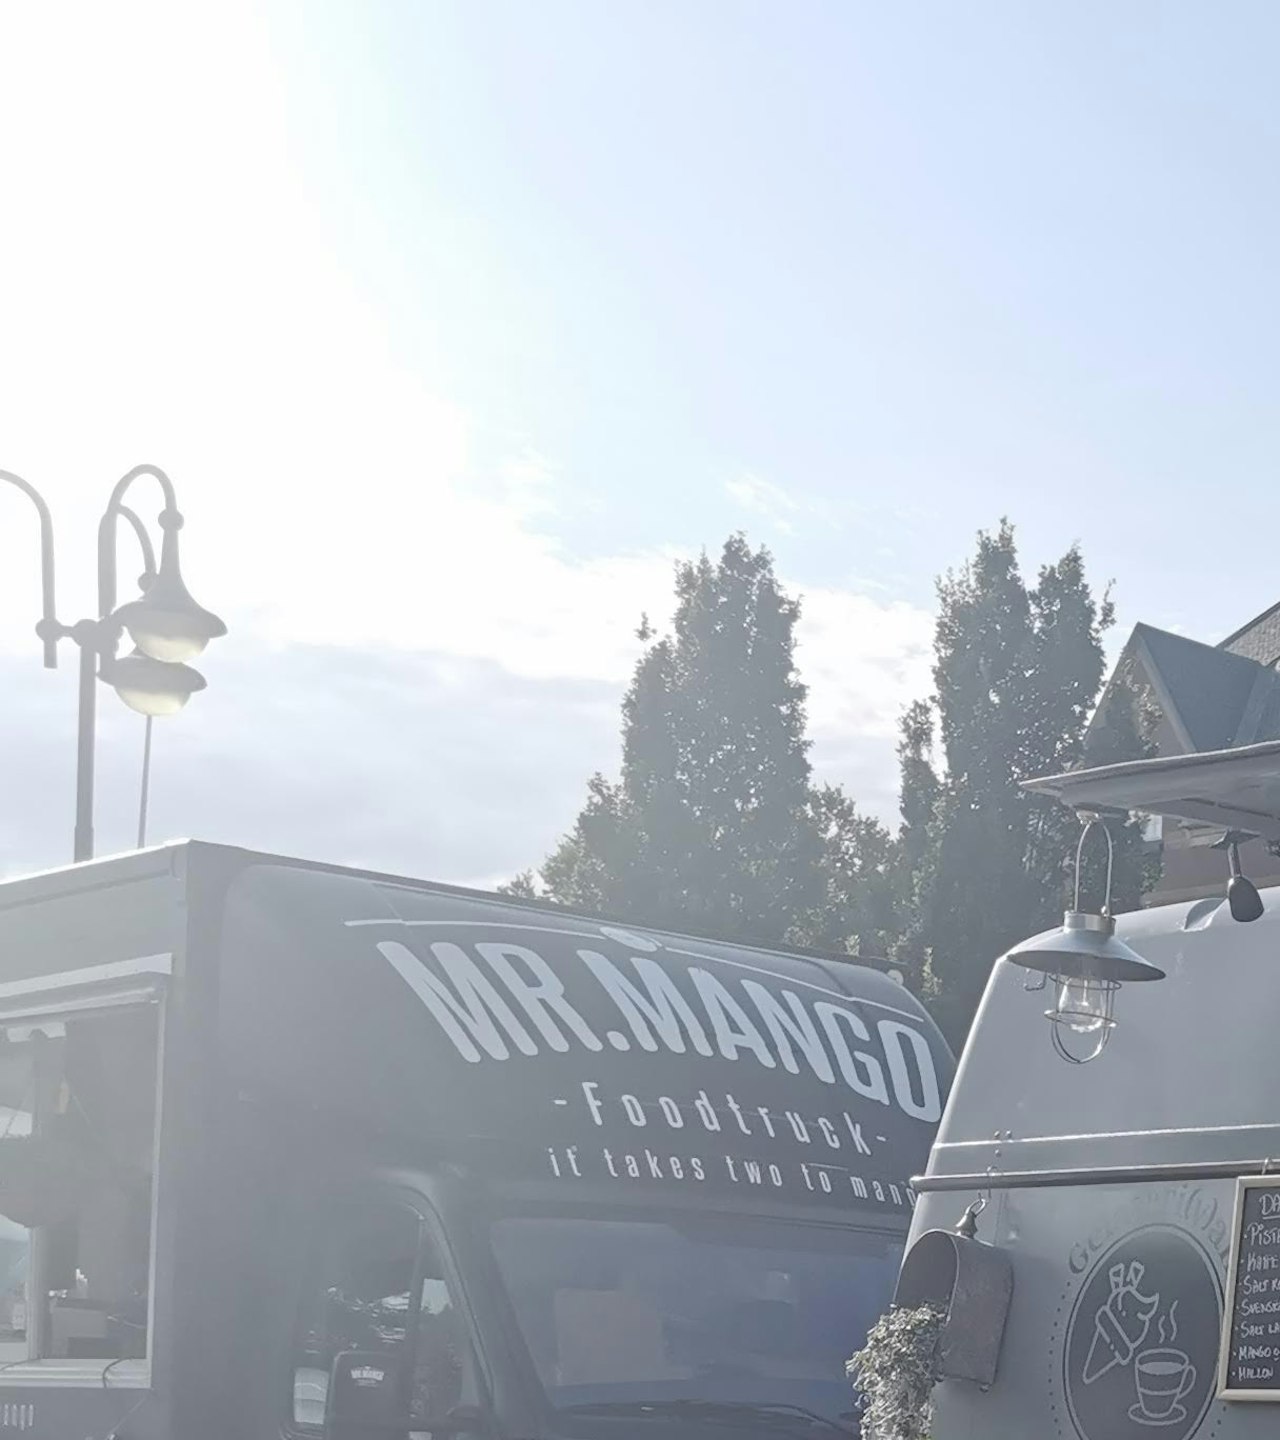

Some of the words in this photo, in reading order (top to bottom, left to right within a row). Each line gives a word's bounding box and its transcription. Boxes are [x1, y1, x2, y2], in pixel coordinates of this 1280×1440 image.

[376, 941, 941, 1122] MR.MANGO
[548, 1146, 581, 1177] it
[604, 1147, 704, 1181] takes
[726, 1155, 782, 1188] two
[802, 1163, 832, 1194] to
